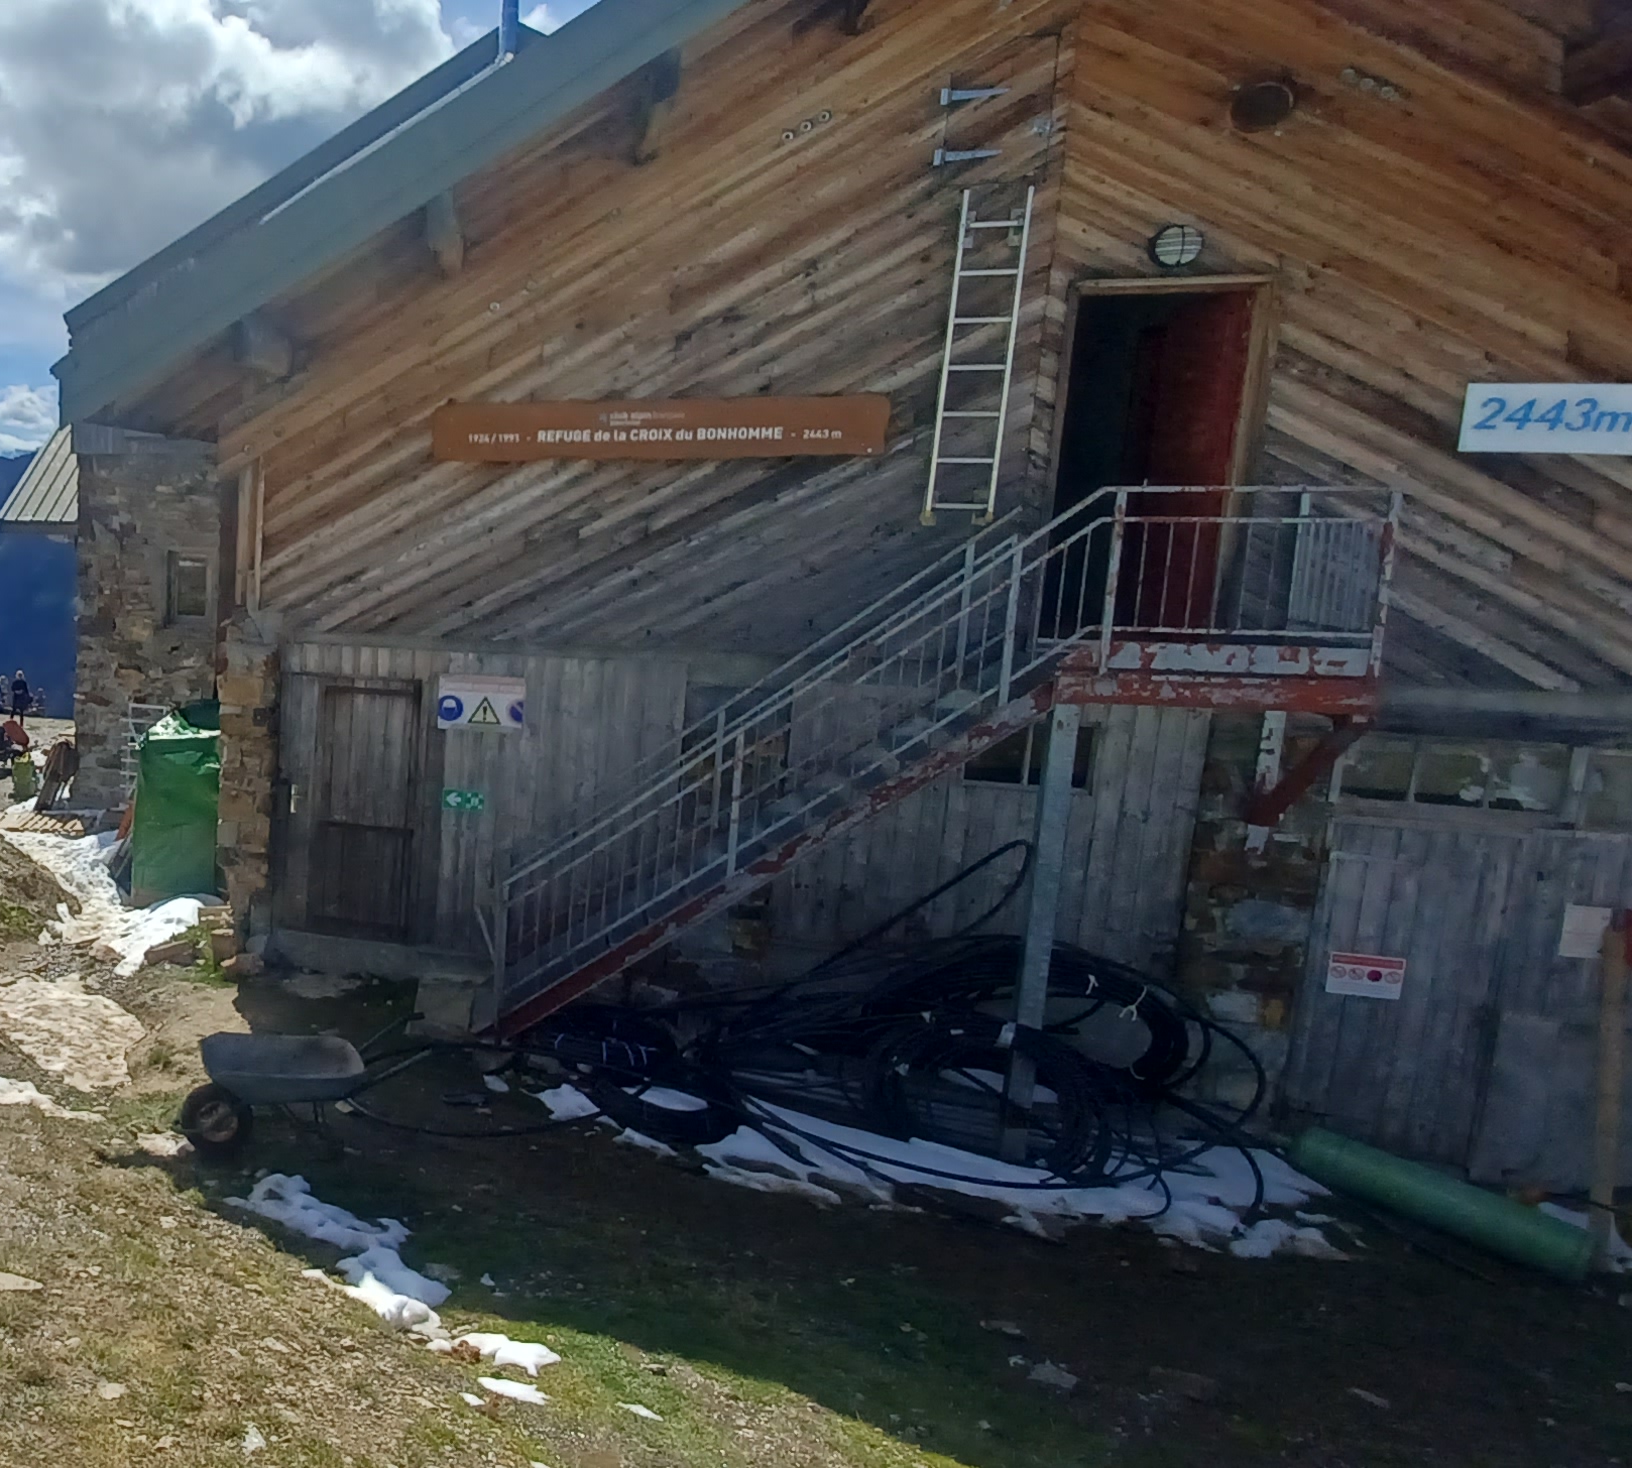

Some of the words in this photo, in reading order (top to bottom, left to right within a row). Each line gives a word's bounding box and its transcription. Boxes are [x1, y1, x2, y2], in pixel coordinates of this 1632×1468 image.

[1472, 397, 1632, 432] 2443m
[536, 428, 591, 443] REFUGE
[594, 429, 611, 442] de
[613, 429, 627, 442] la
[630, 427, 673, 442] CROIX
[675, 428, 693, 441] du
[697, 426, 784, 441] BONHOMME
